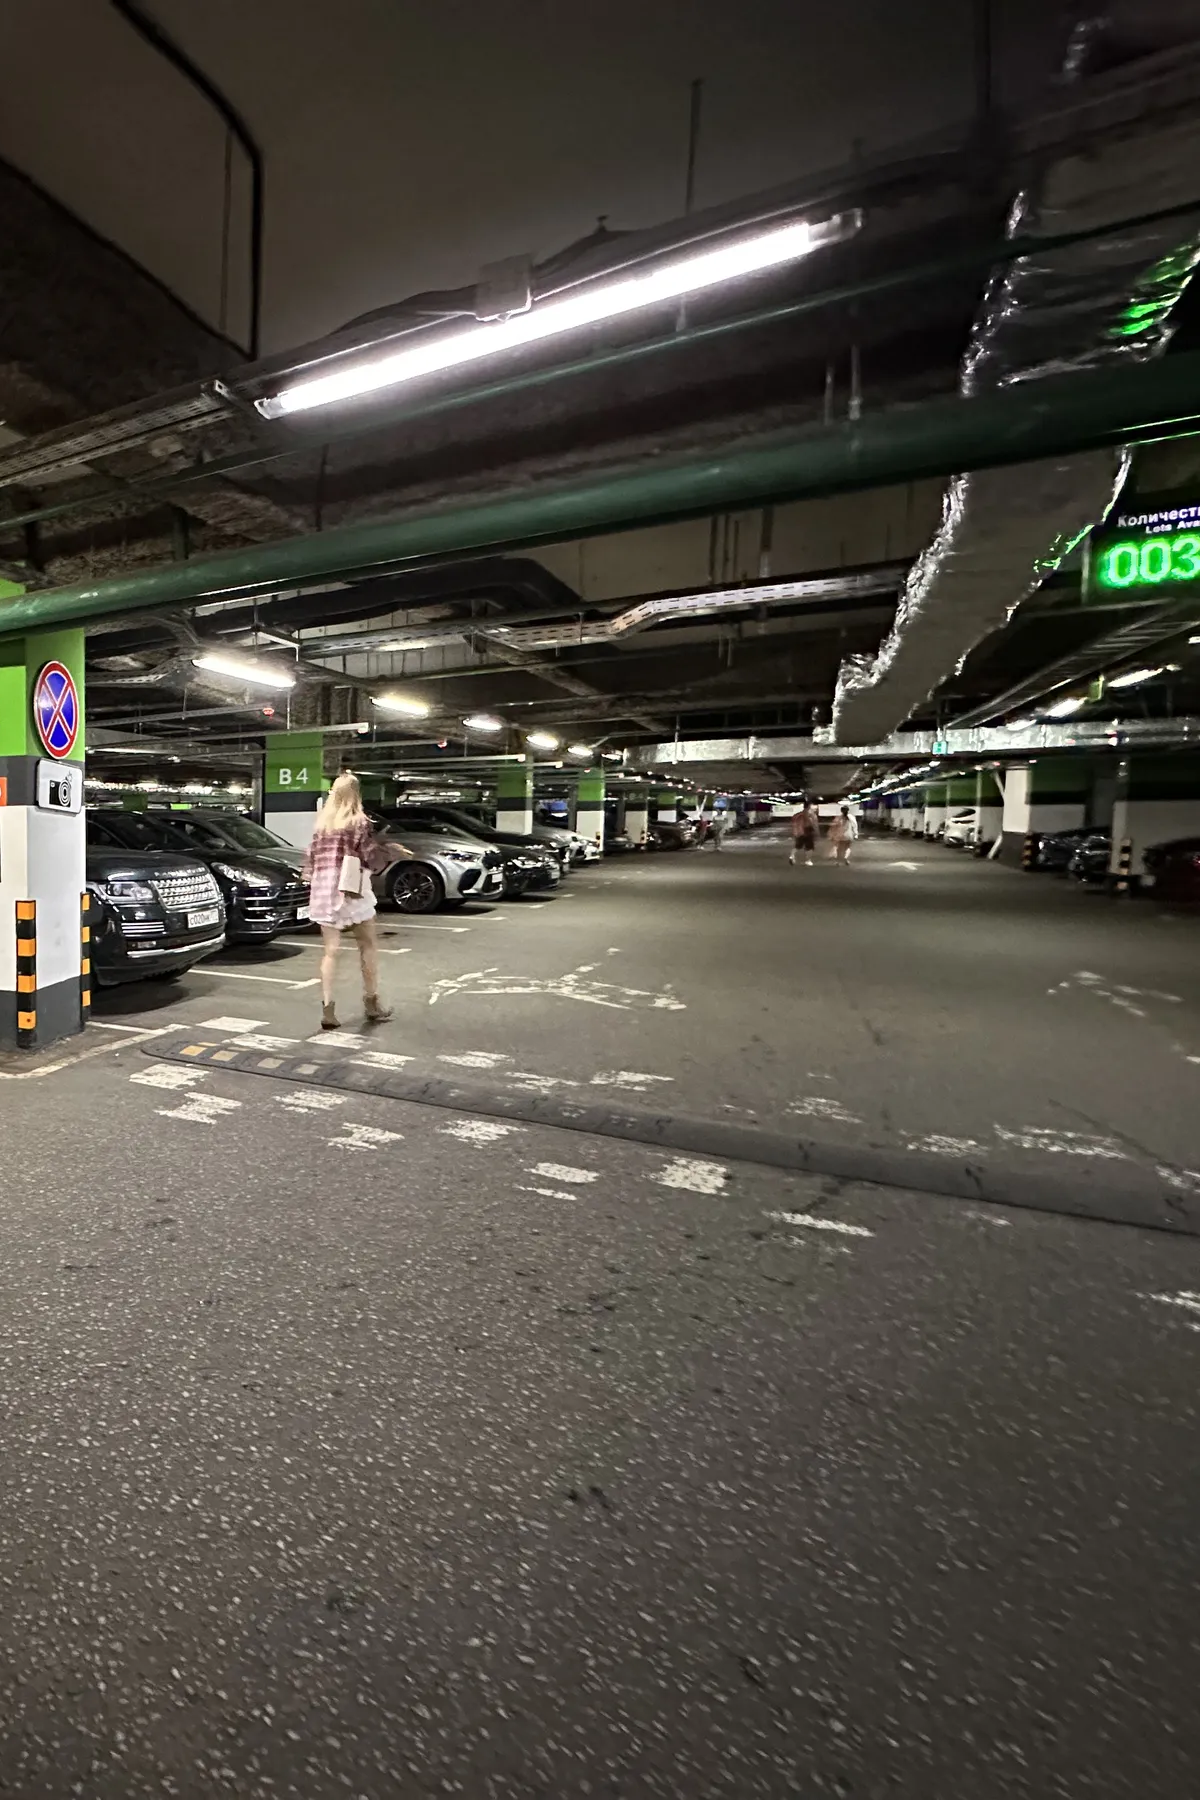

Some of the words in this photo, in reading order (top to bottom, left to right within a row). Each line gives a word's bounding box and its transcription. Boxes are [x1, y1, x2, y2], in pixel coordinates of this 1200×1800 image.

[1117, 506, 1200, 527] Количест
[1145, 524, 1172, 534] Lots
[1104, 534, 1200, 587] 003
